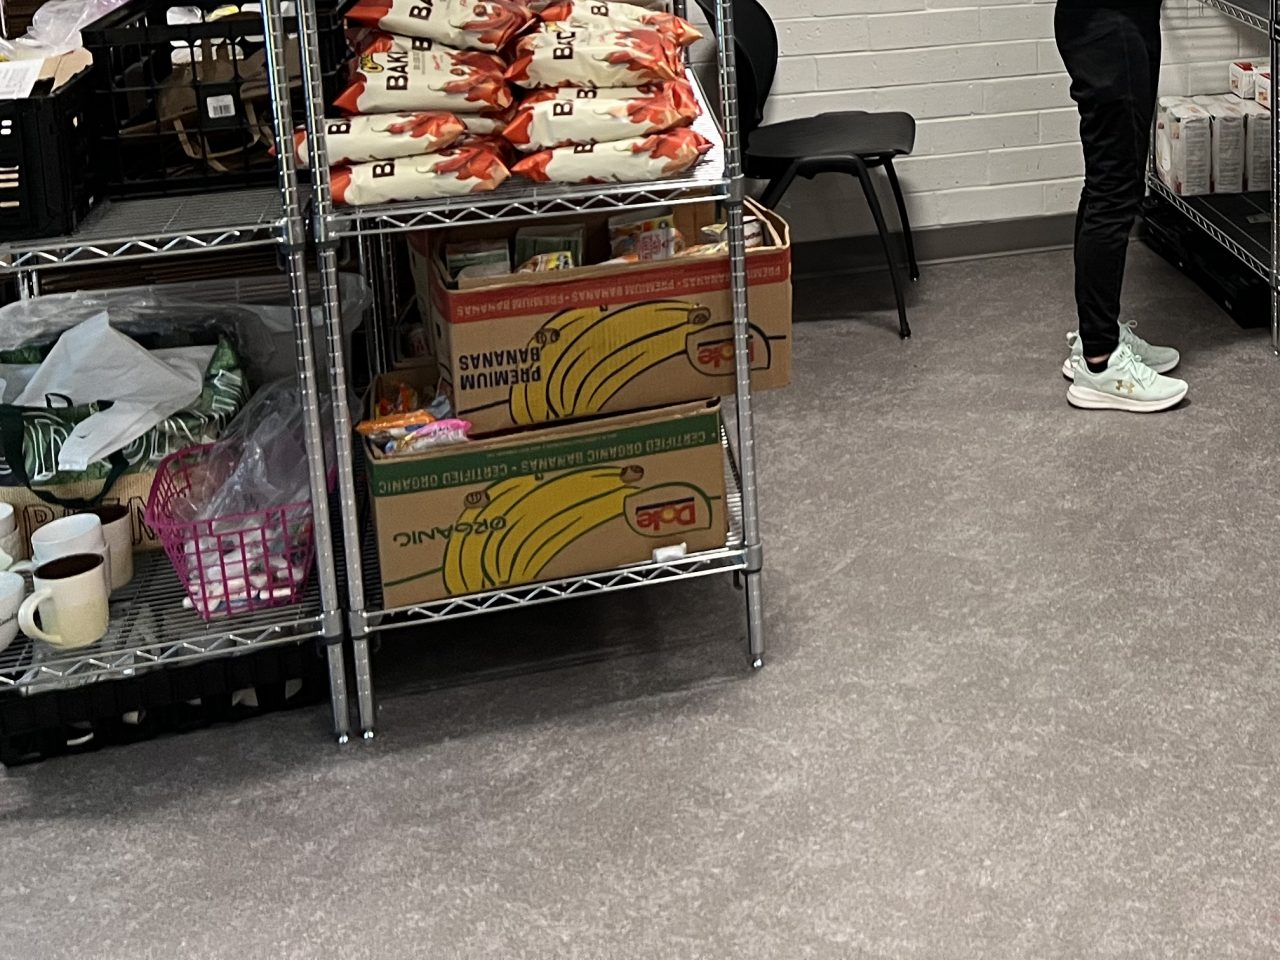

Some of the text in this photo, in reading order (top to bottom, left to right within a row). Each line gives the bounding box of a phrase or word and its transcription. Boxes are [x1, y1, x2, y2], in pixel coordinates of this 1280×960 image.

[571, 284, 624, 304] BANANAS
[459, 346, 541, 371] BANANAS
[460, 365, 541, 390] PREMIUM
[590, 440, 643, 460] ORGANIC
[648, 430, 707, 451] CERTIFIED
[521, 450, 586, 473] BANANAS
[378, 473, 439, 494] ORGANIC
[441, 464, 508, 486] CERTIFIED
[636, 501, 696, 532] Dole
[392, 515, 507, 548] ORGANIC
